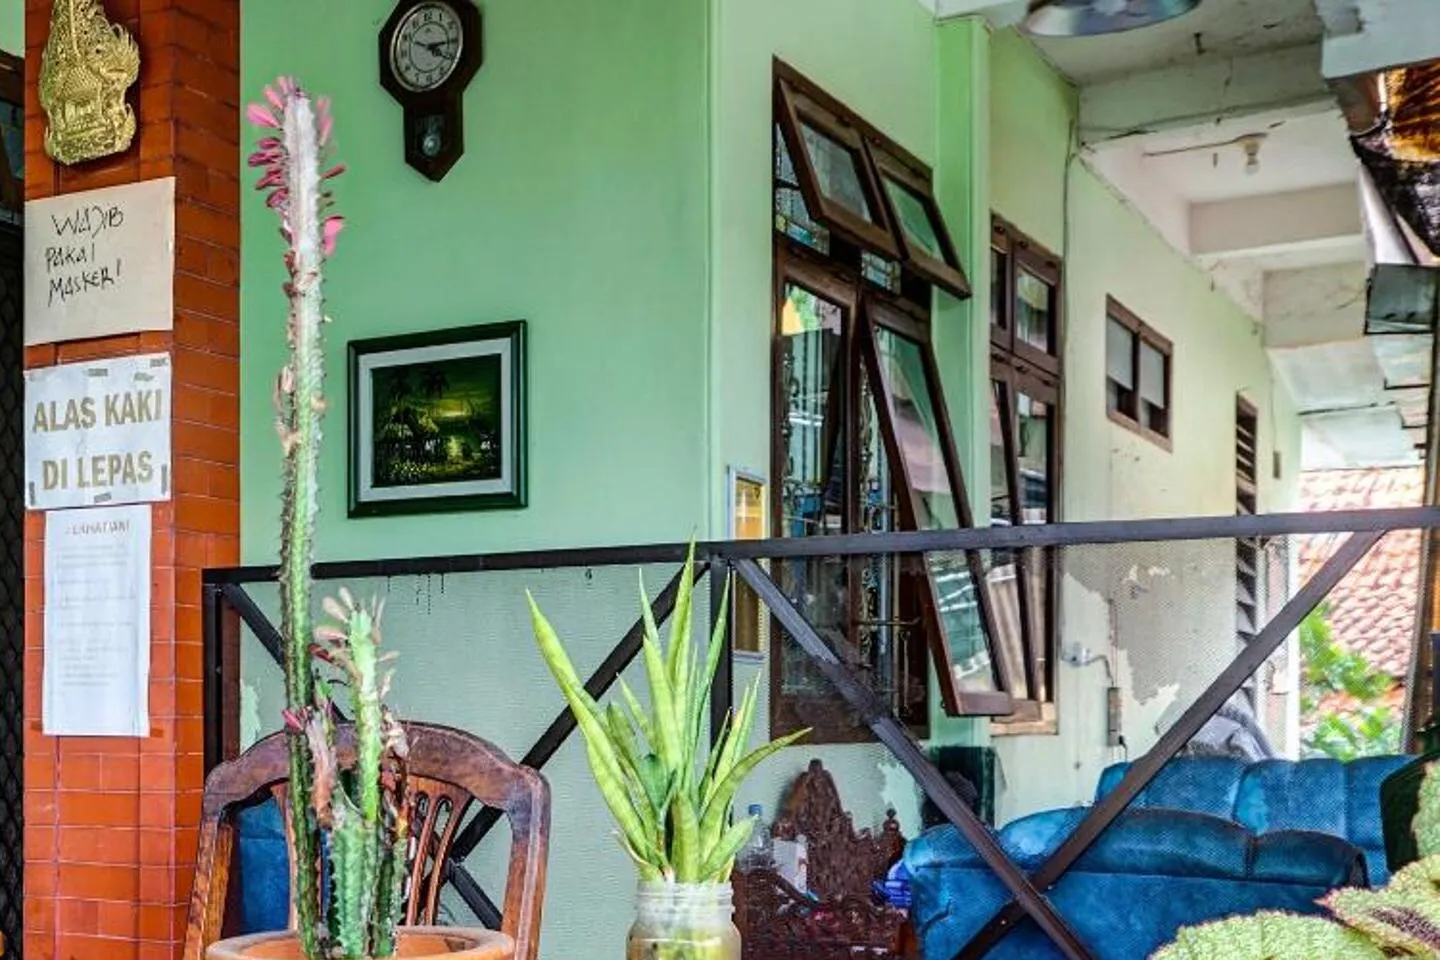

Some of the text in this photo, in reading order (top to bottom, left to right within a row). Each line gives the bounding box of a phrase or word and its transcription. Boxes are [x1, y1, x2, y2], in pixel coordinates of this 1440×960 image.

[51, 206, 124, 239] WAJIB
[45, 242, 95, 274] PAKAI
[32, 388, 163, 433] ALAS KAKI
[42, 450, 154, 490] DI LEPAS
